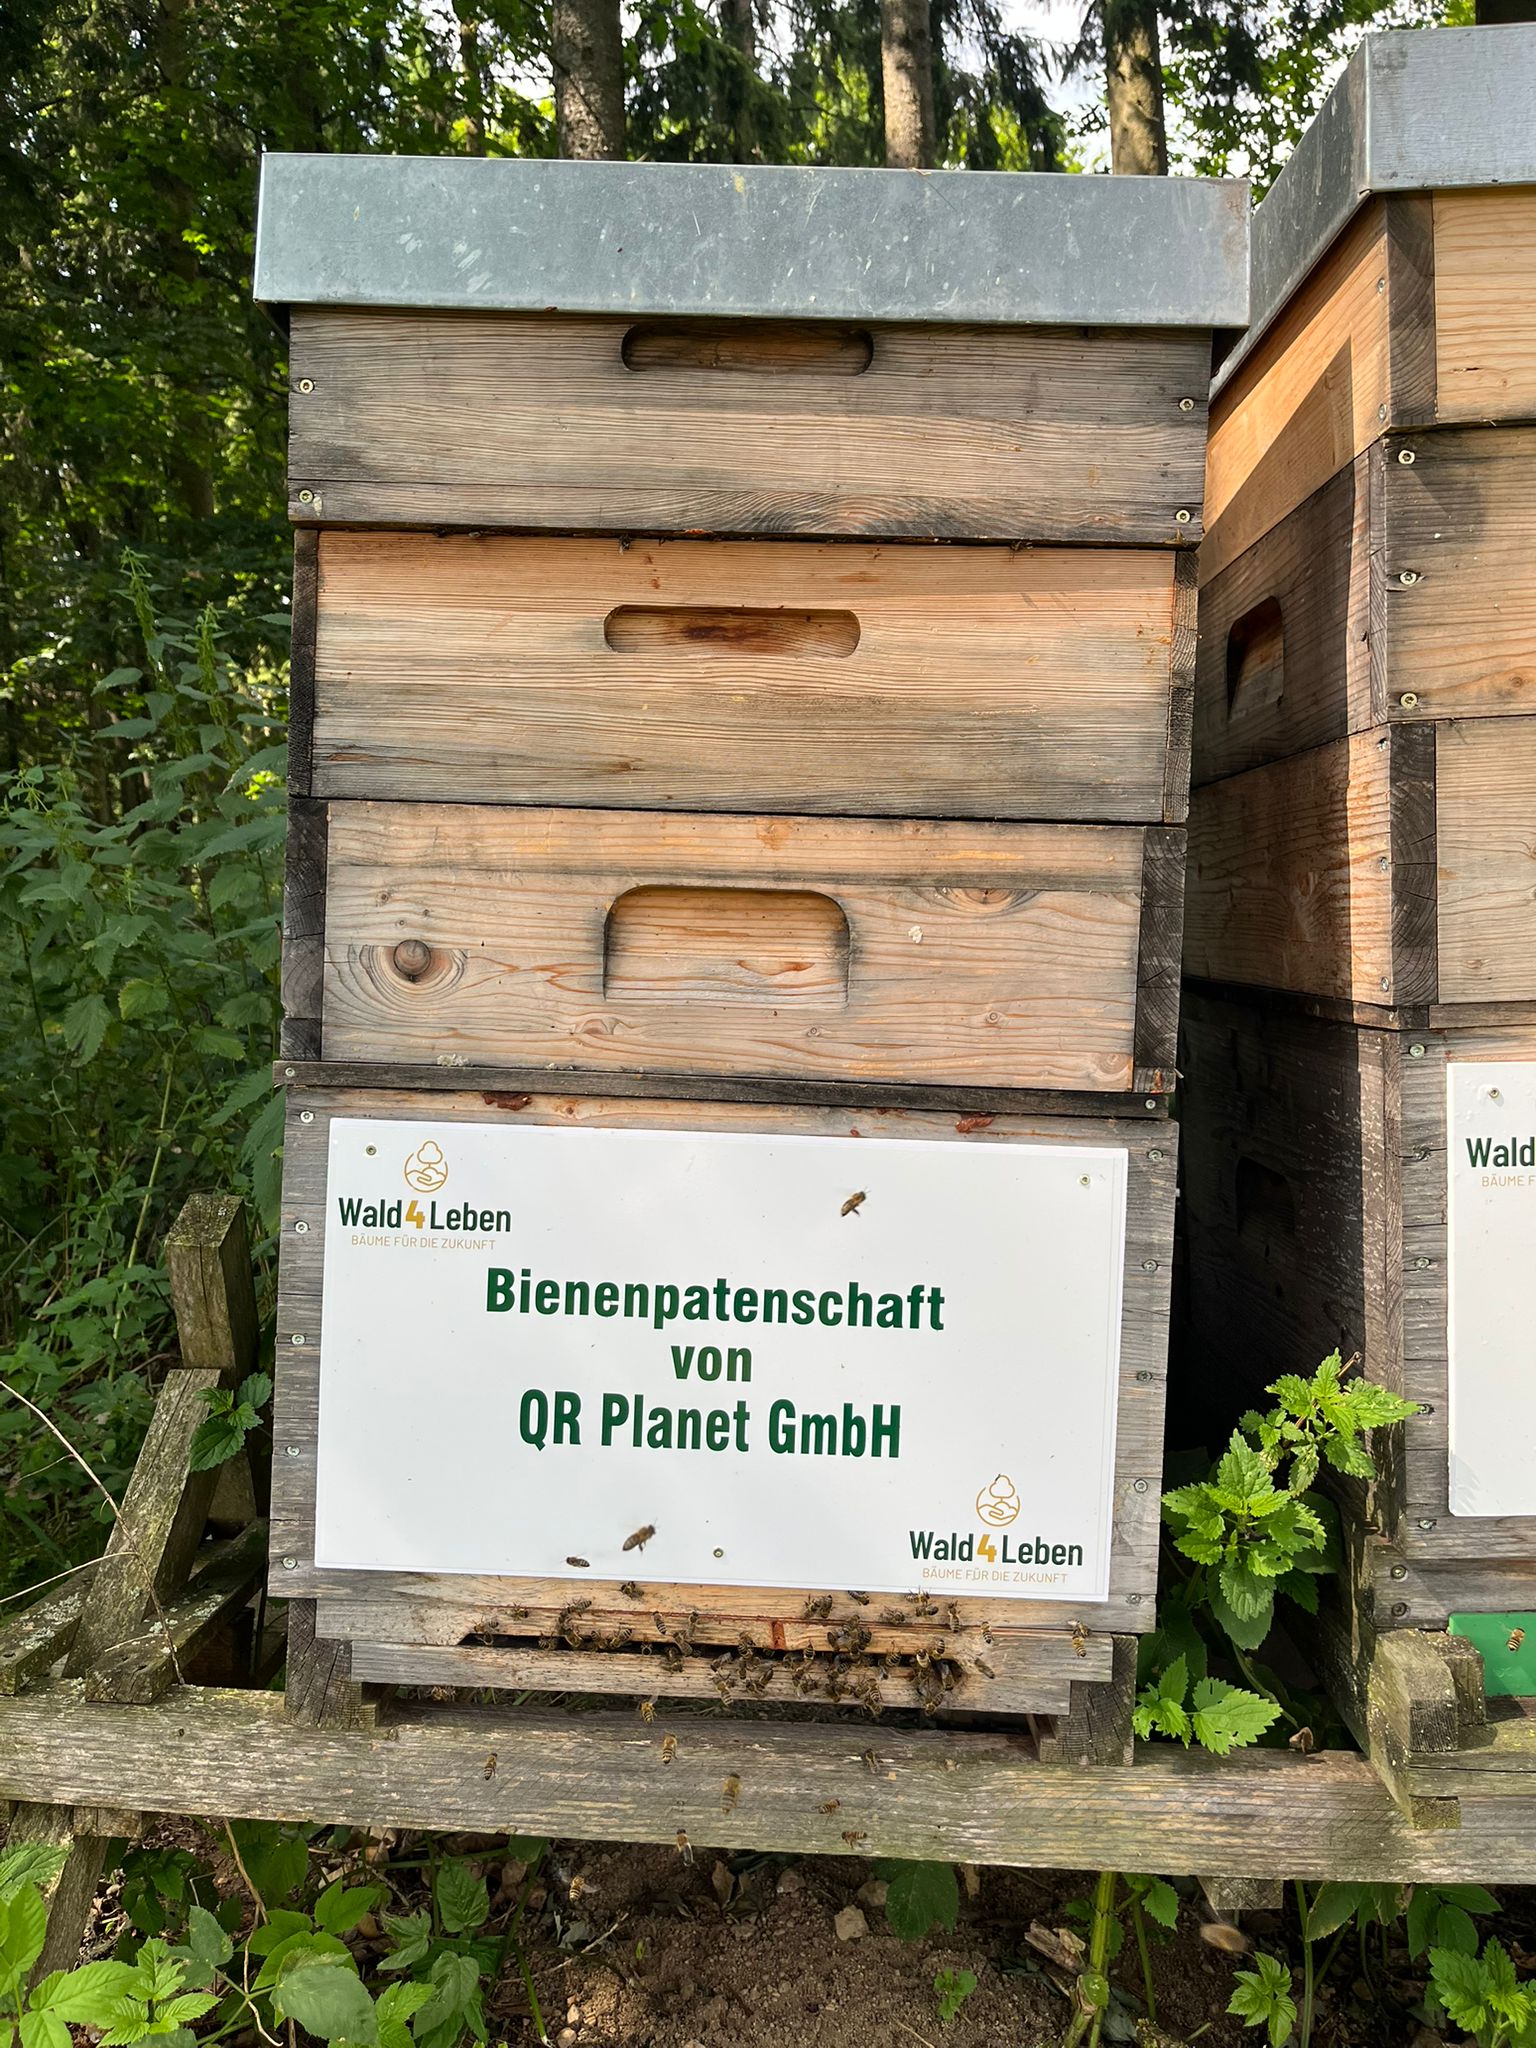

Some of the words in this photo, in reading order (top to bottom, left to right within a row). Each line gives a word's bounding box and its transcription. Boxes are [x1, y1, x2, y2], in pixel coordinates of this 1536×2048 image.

[1481, 1173, 1525, 1187] BÄUME
[338, 1197, 512, 1232] Wald4Leben
[351, 1233, 391, 1247] BÄUME
[394, 1234, 418, 1248] FÜR
[420, 1236, 438, 1249] DIE
[441, 1238, 496, 1250] ZUKUNFT
[486, 1267, 945, 1331] Bienenpatenschaft
[670, 1345, 752, 1382] von
[519, 1389, 582, 1452] QR
[601, 1392, 750, 1453] Planet
[768, 1399, 901, 1458] GmbH
[909, 1530, 1083, 1566] Wald4Leben
[922, 1566, 962, 1580] BÄUME
[965, 1567, 989, 1581] FÜR
[992, 1570, 1010, 1582] DIE
[1013, 1571, 1068, 1584] ZUKUNFT
